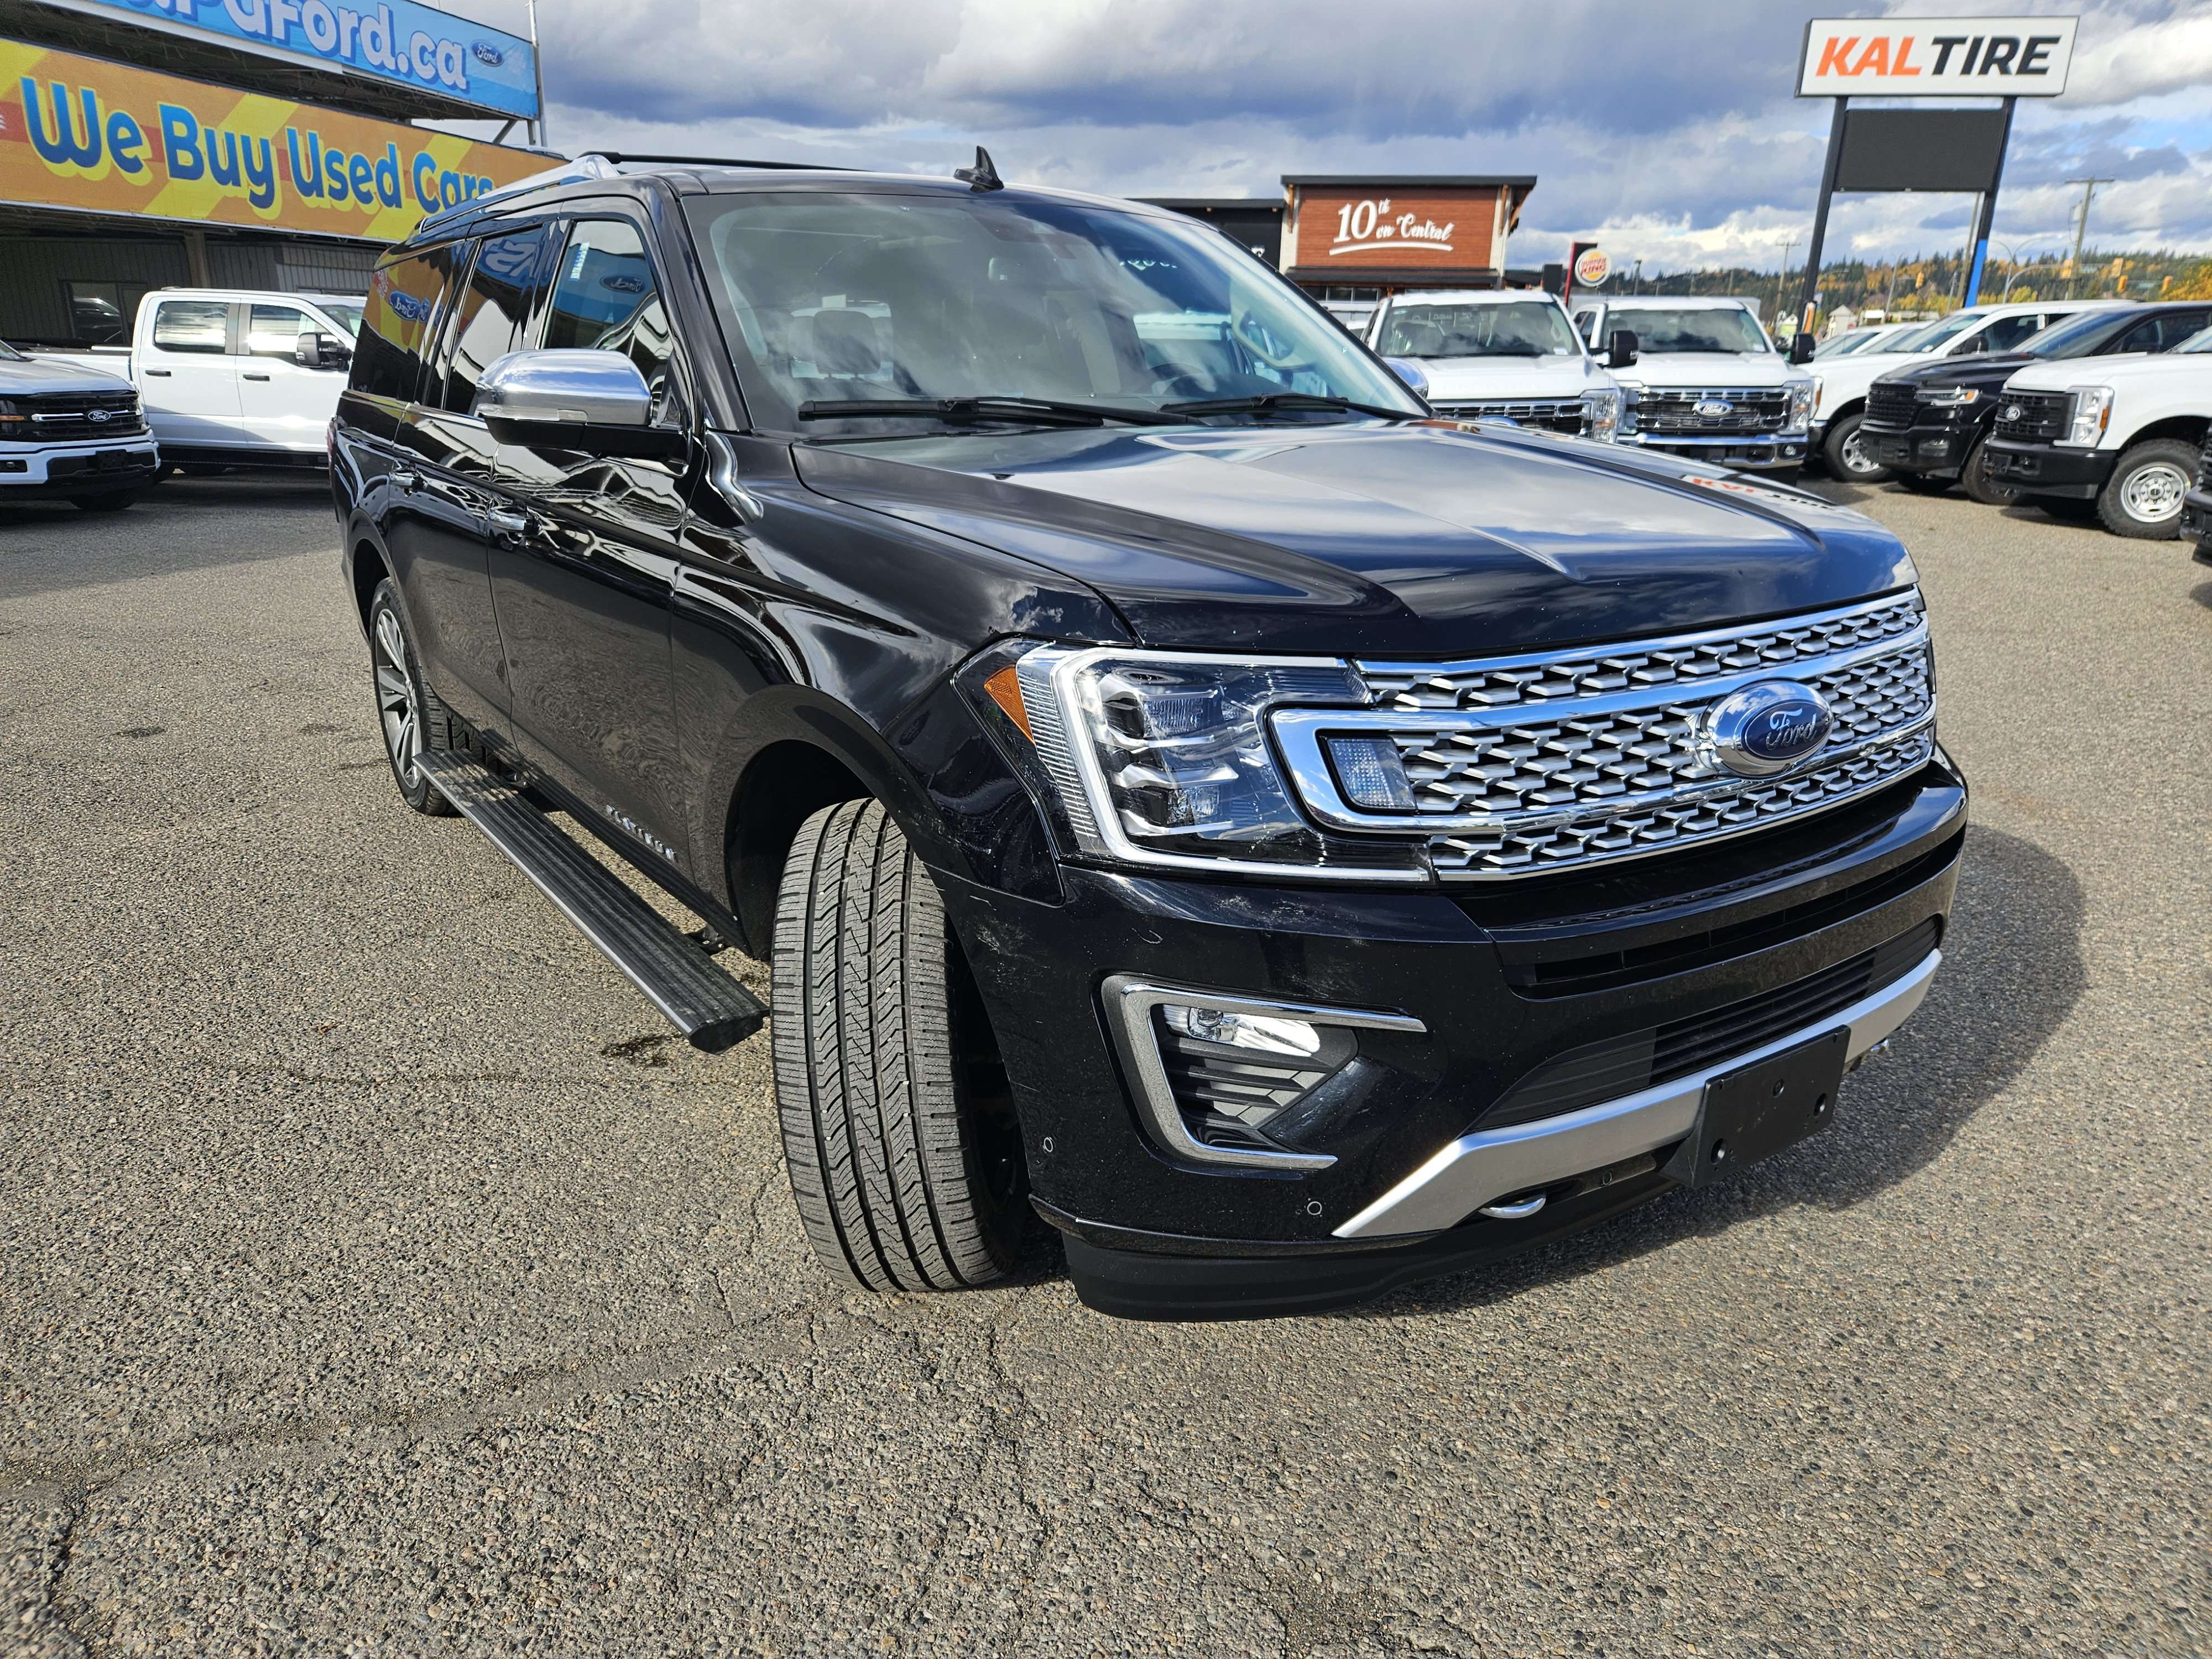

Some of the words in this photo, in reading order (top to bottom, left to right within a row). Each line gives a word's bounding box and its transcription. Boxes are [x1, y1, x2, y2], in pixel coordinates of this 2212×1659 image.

[477, 43, 498, 64] Ford
[1815, 36, 1923, 76] KAL
[1931, 35, 2062, 76] TIRE
[20, 76, 144, 174] We
[158, 102, 275, 209] Buy
[286, 127, 403, 209] Used
[1375, 225, 1396, 239] on
[1396, 212, 1454, 241] Central
[1766, 708, 1816, 750] Ford
